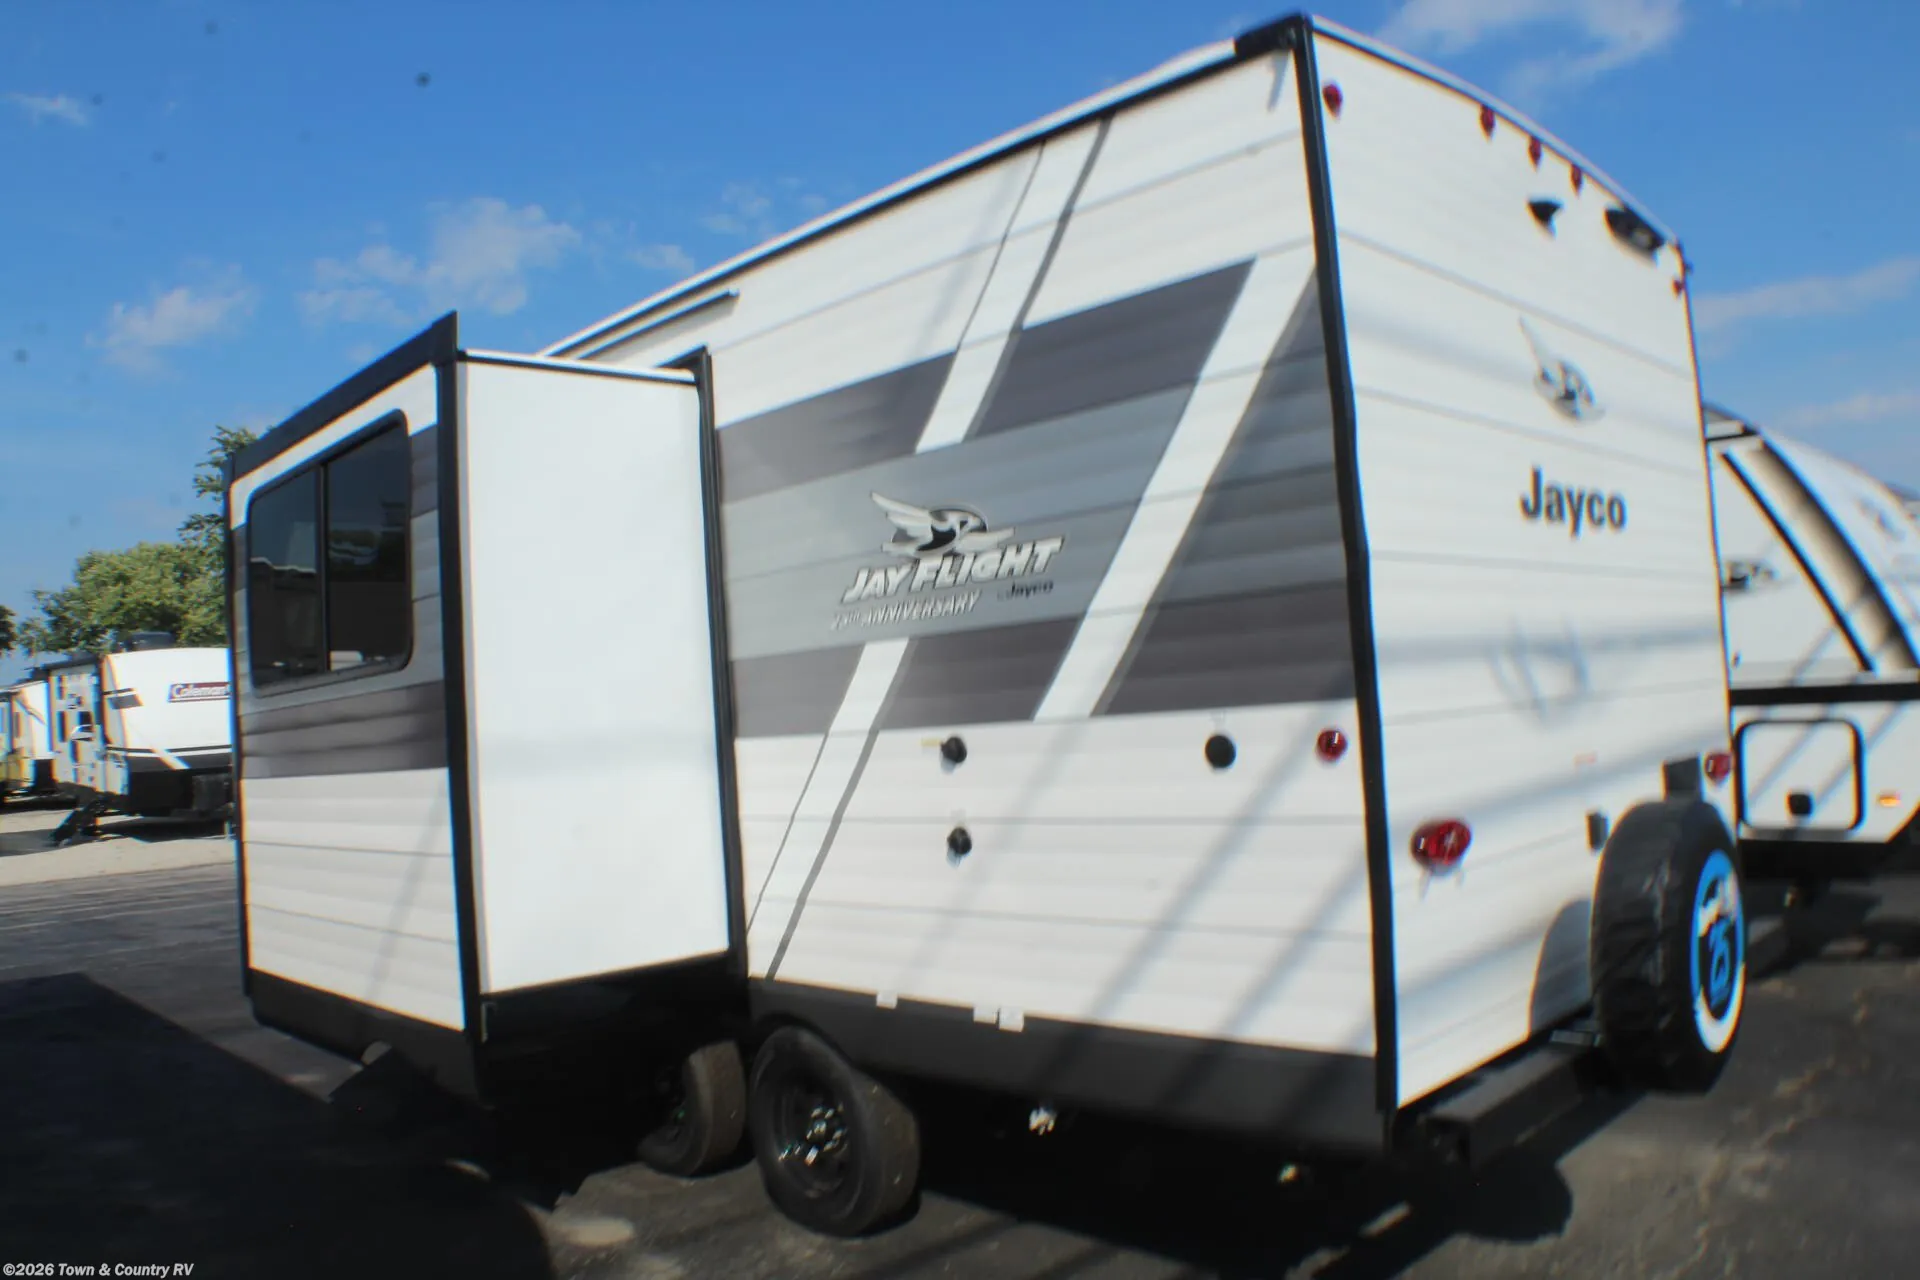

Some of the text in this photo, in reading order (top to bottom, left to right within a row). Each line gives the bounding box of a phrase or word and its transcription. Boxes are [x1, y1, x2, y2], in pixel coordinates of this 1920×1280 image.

[1520, 464, 1627, 539] Jayco
[842, 537, 1064, 604] JAY FLIGHT
